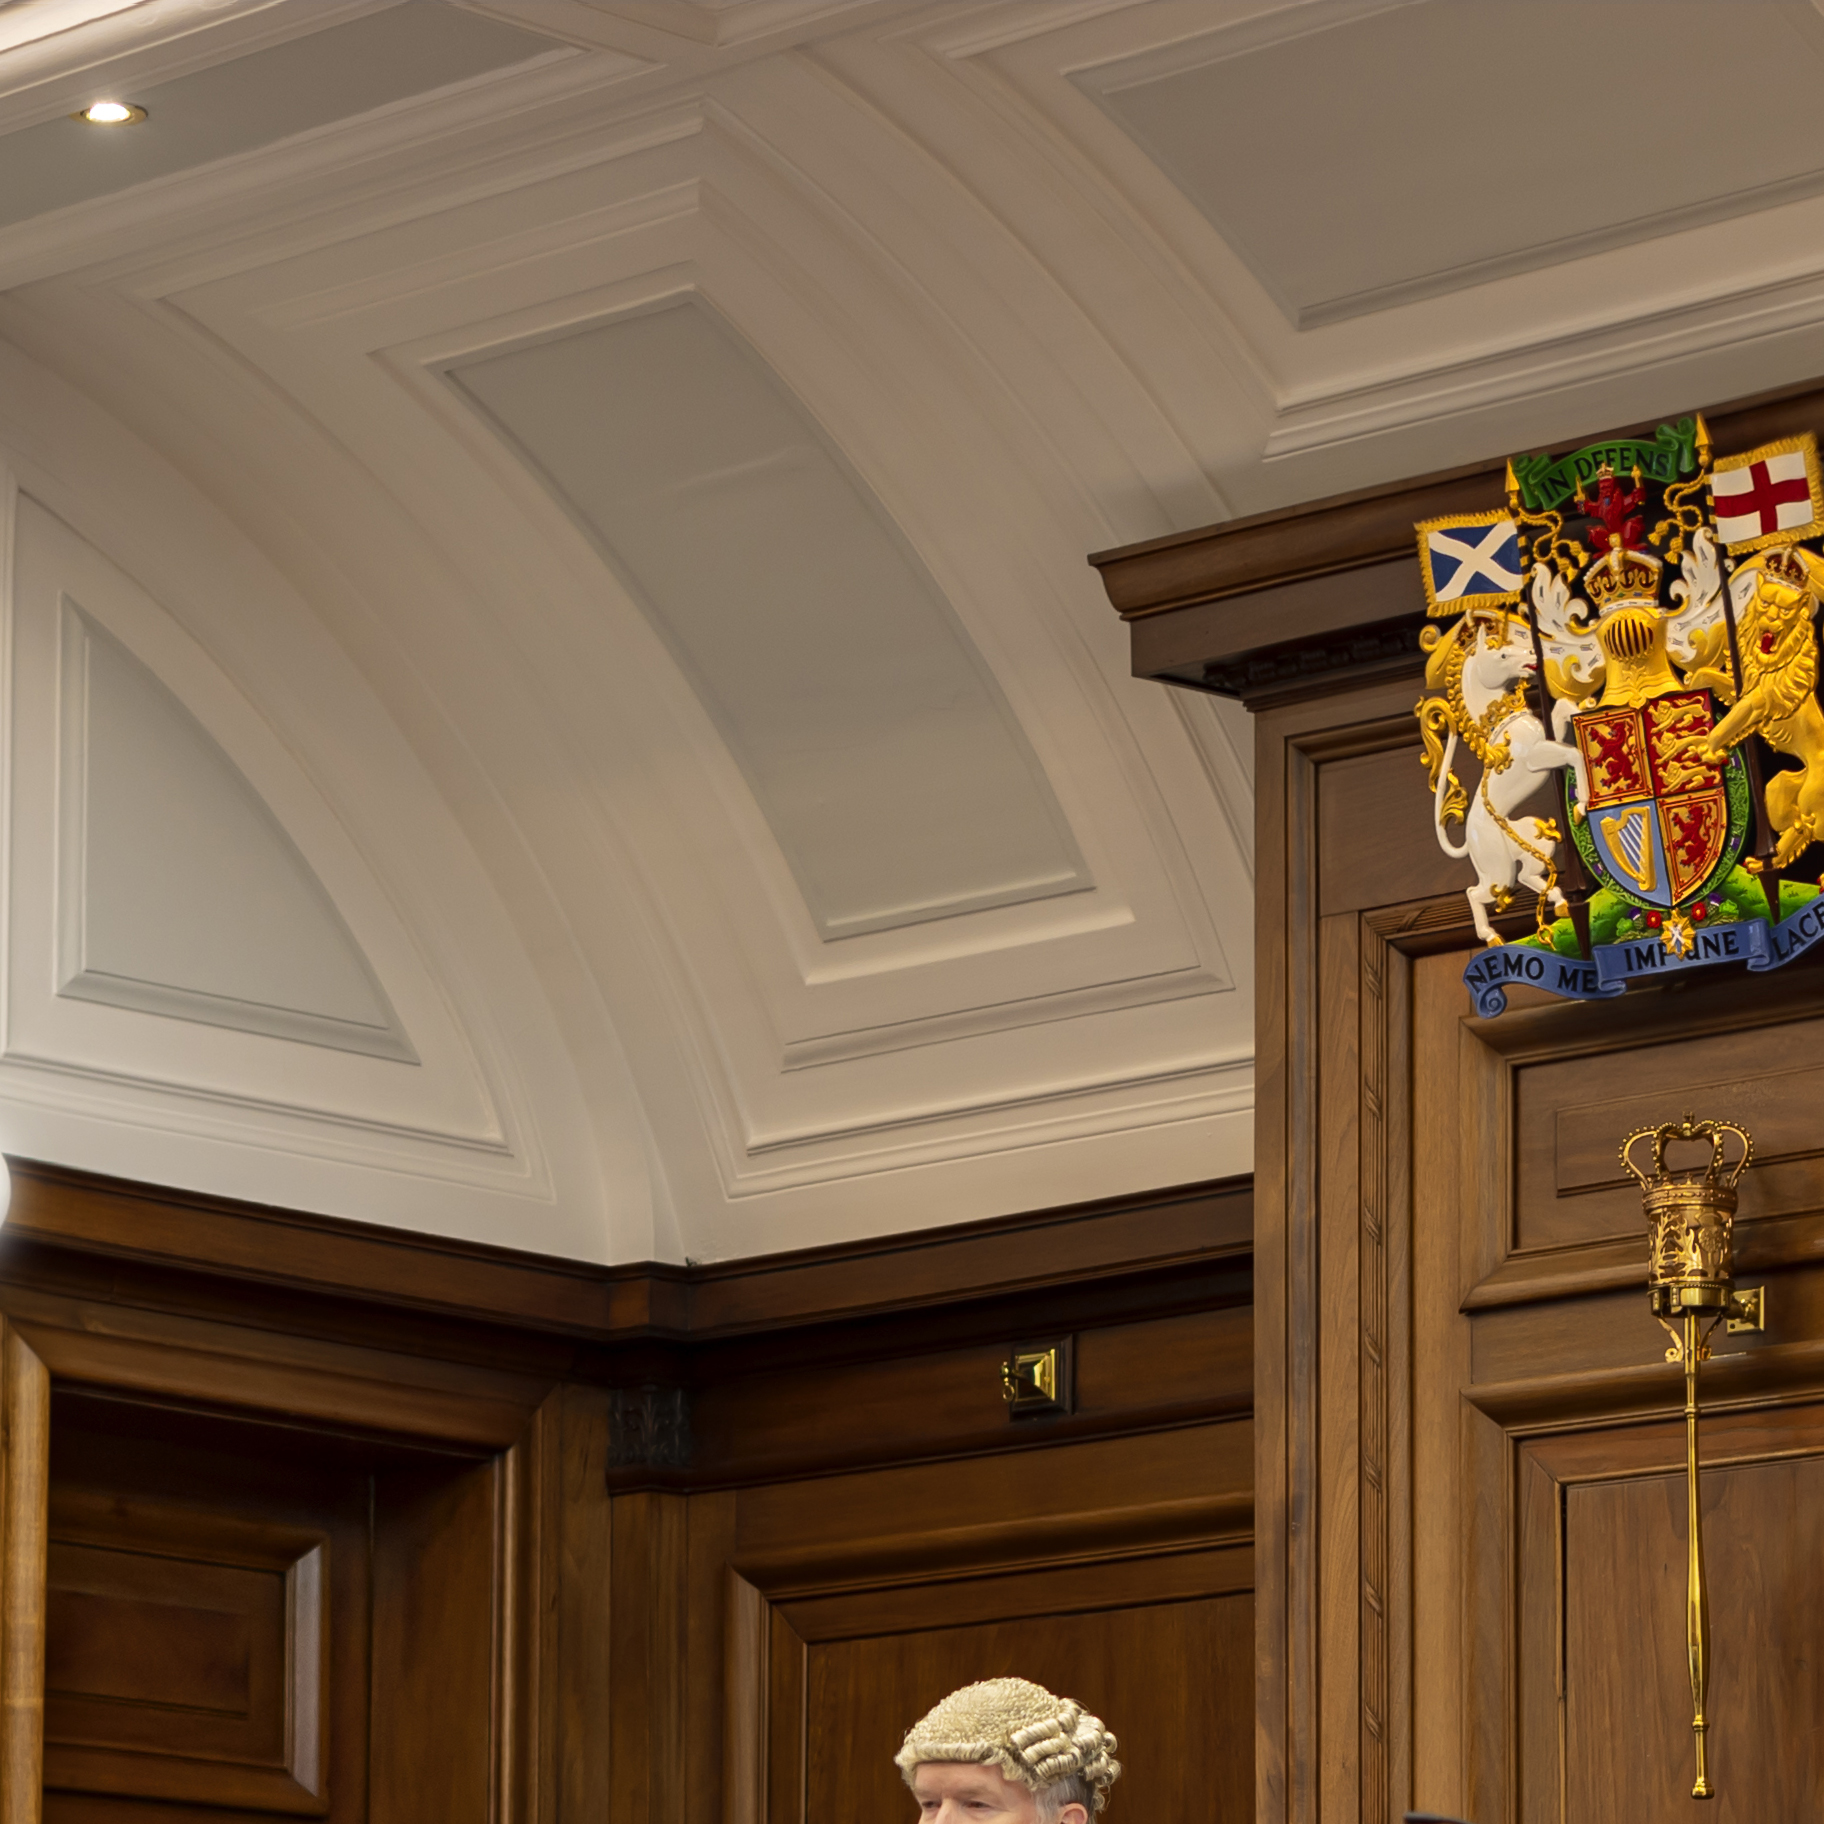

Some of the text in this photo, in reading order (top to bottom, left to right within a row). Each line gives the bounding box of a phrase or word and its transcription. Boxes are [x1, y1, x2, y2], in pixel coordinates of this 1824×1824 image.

[1541, 447, 1670, 503] IN DEFENS
[1466, 952, 1545, 992] NEMO
[1557, 964, 1597, 993] ME
